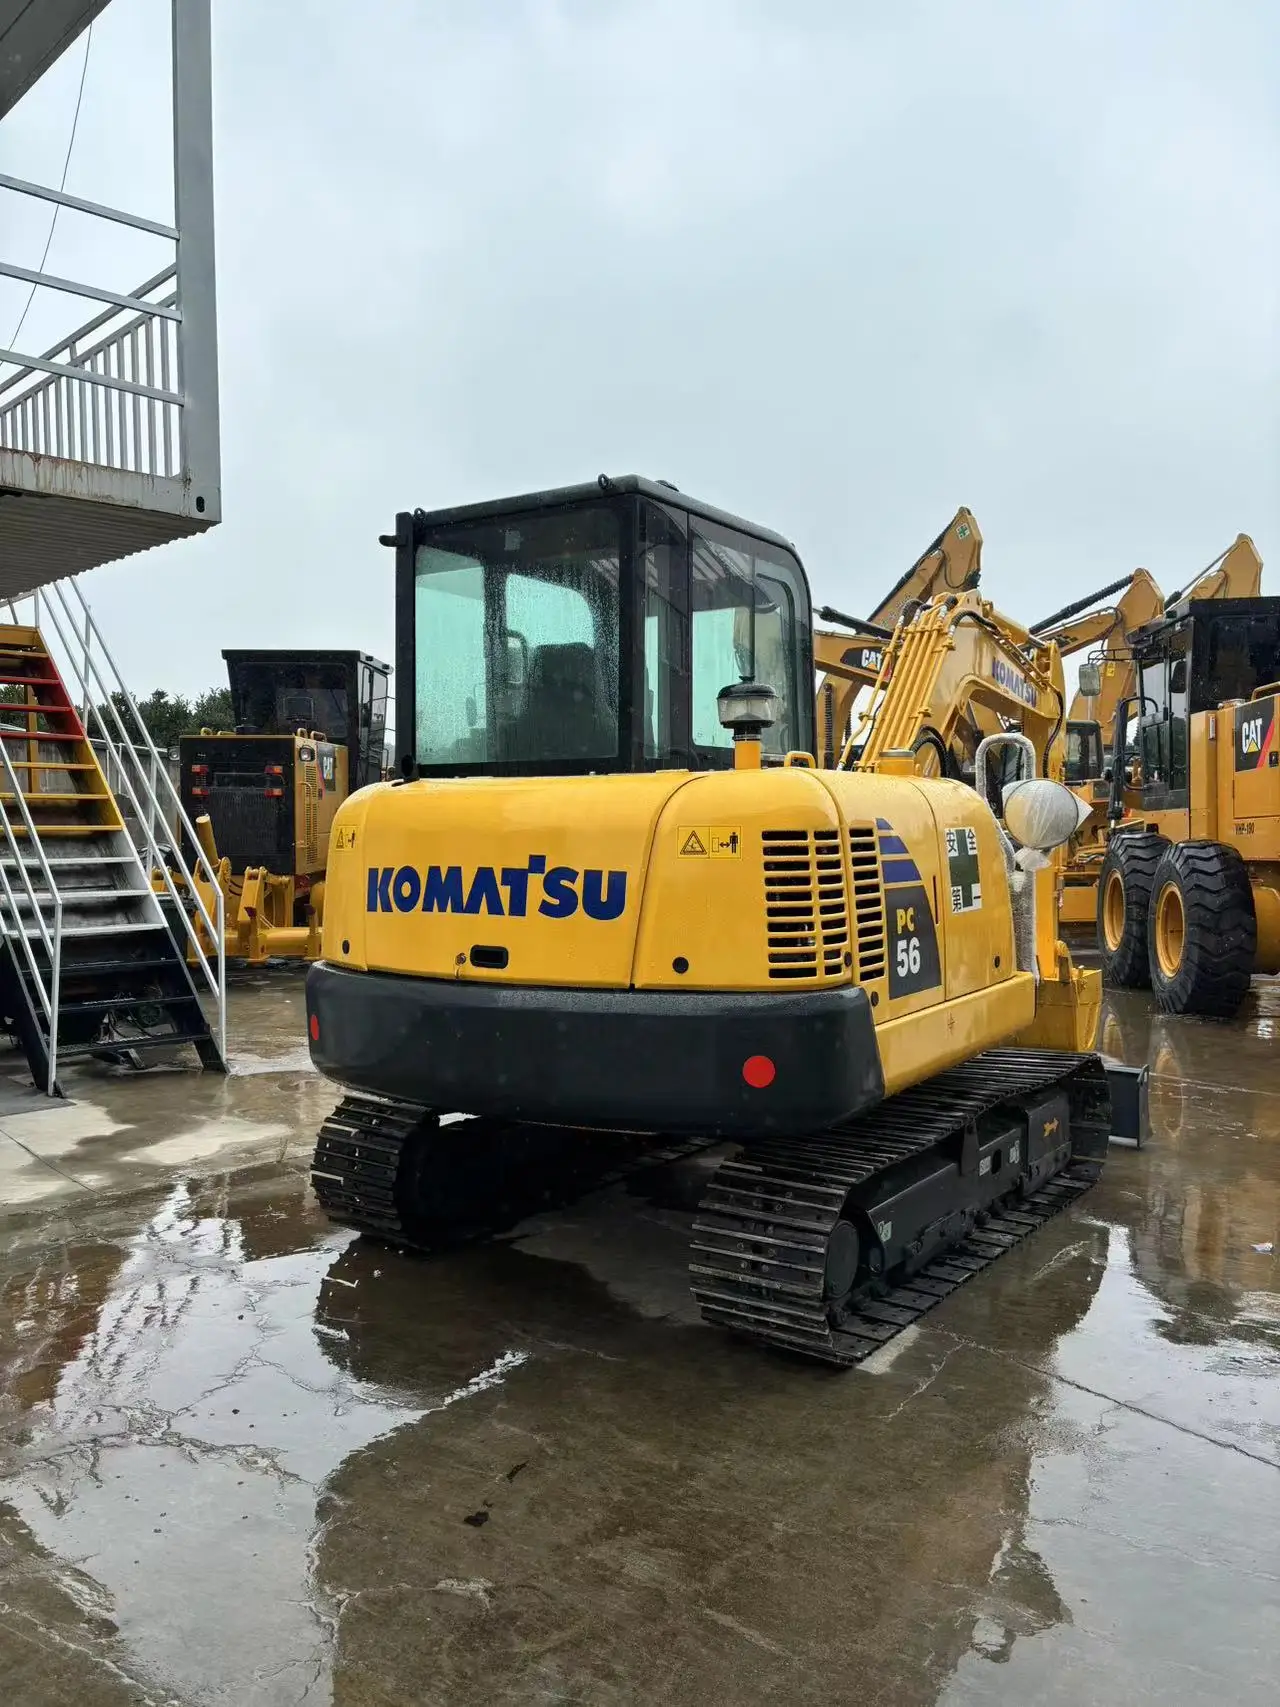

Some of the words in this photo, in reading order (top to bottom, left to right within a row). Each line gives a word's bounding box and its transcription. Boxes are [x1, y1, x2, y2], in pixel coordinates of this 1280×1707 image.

[861, 649, 882, 671] CAT
[992, 656, 1036, 708] KOMATSU
[1242, 718, 1262, 754] CAT
[367, 855, 627, 921] KOMATSU
[896, 907, 915, 934] PC
[896, 936, 921, 977] 56
